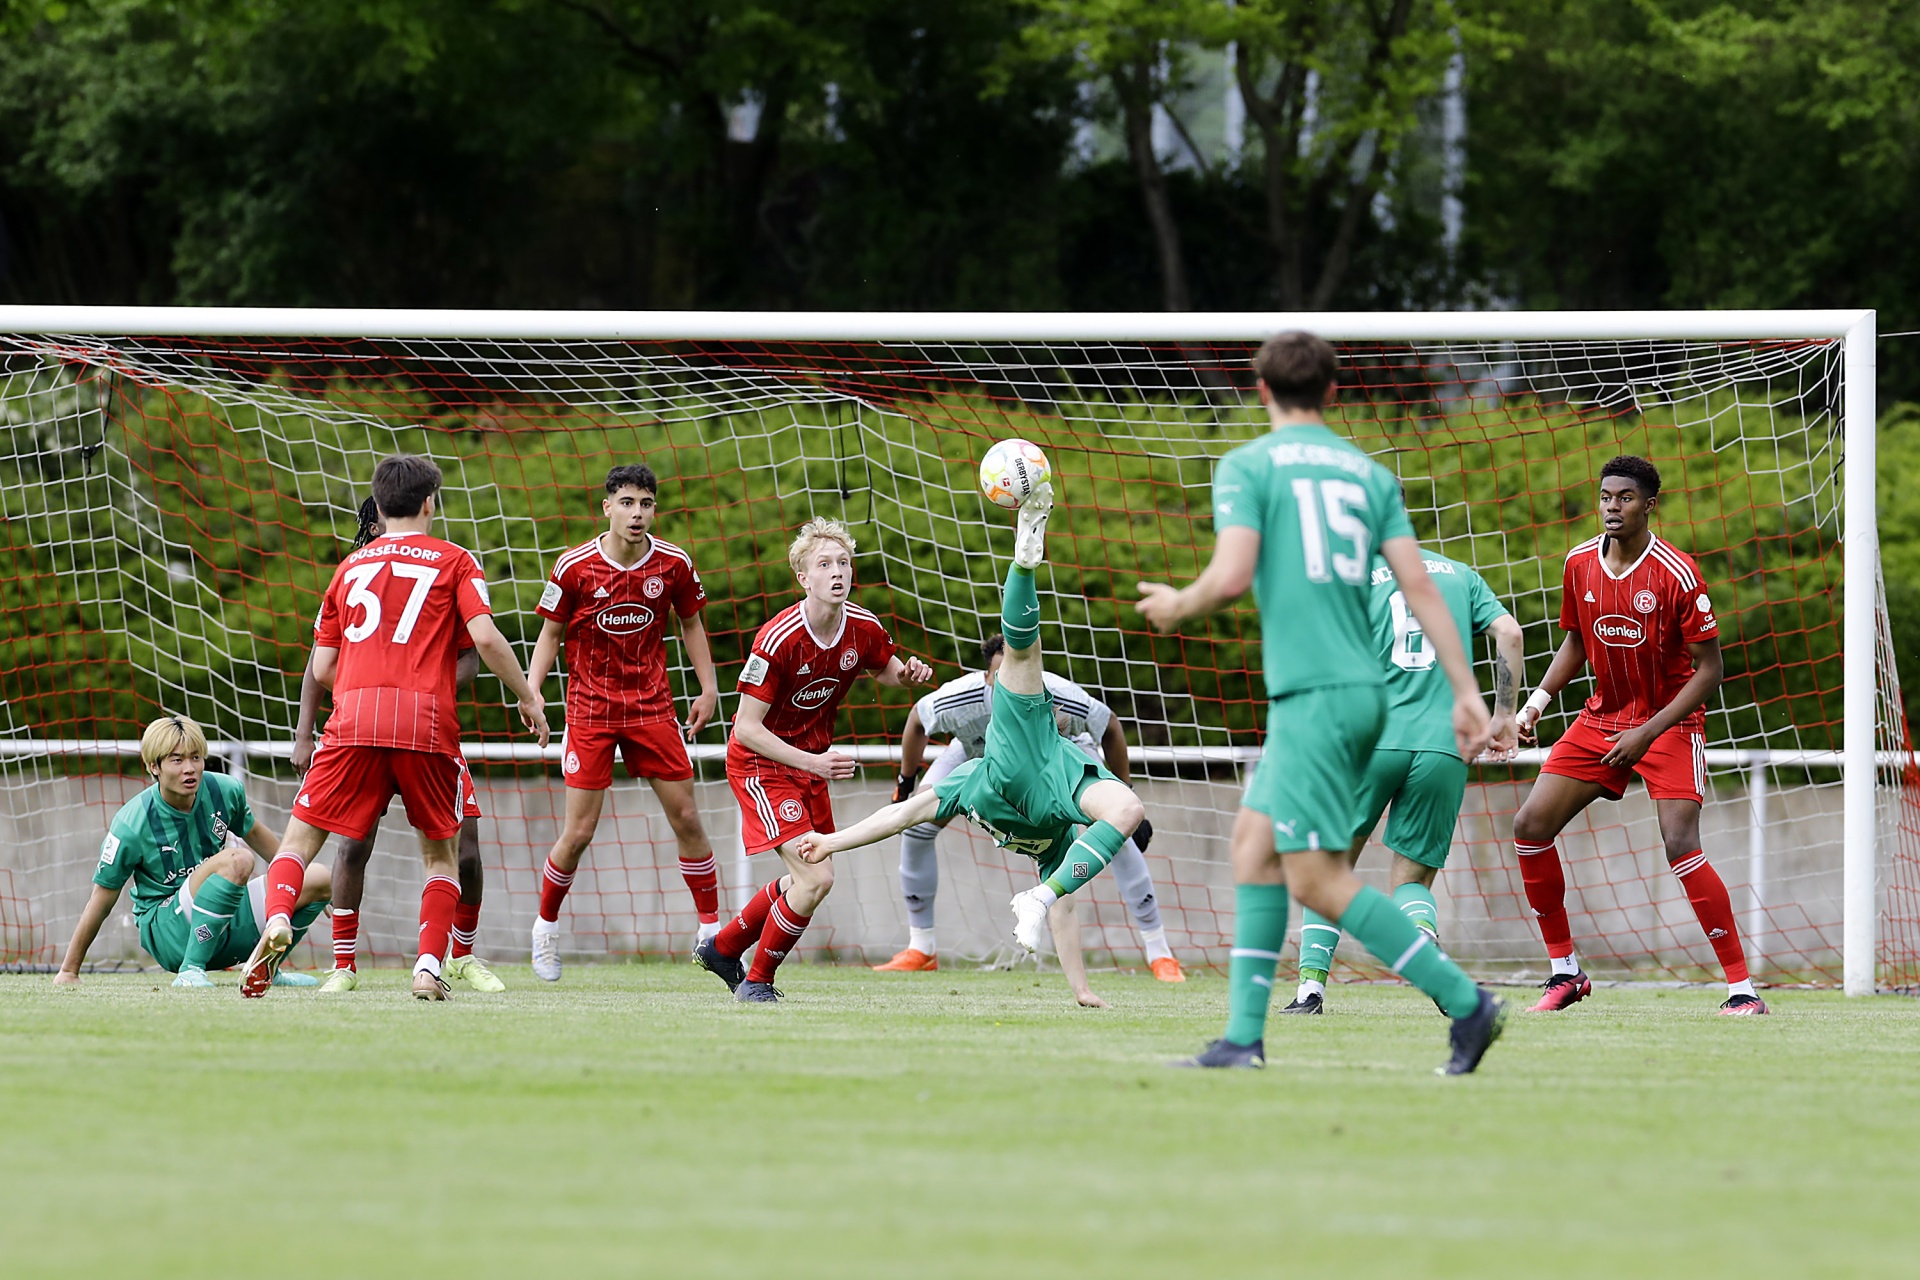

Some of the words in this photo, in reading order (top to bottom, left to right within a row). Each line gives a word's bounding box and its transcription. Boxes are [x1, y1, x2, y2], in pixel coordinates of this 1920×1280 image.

[1014, 457, 1032, 496] DERBYSTA
[1291, 478, 1372, 586] 15
[343, 561, 441, 645] 37
[601, 612, 650, 626] Henkel
[1597, 622, 1642, 640] Henkel
